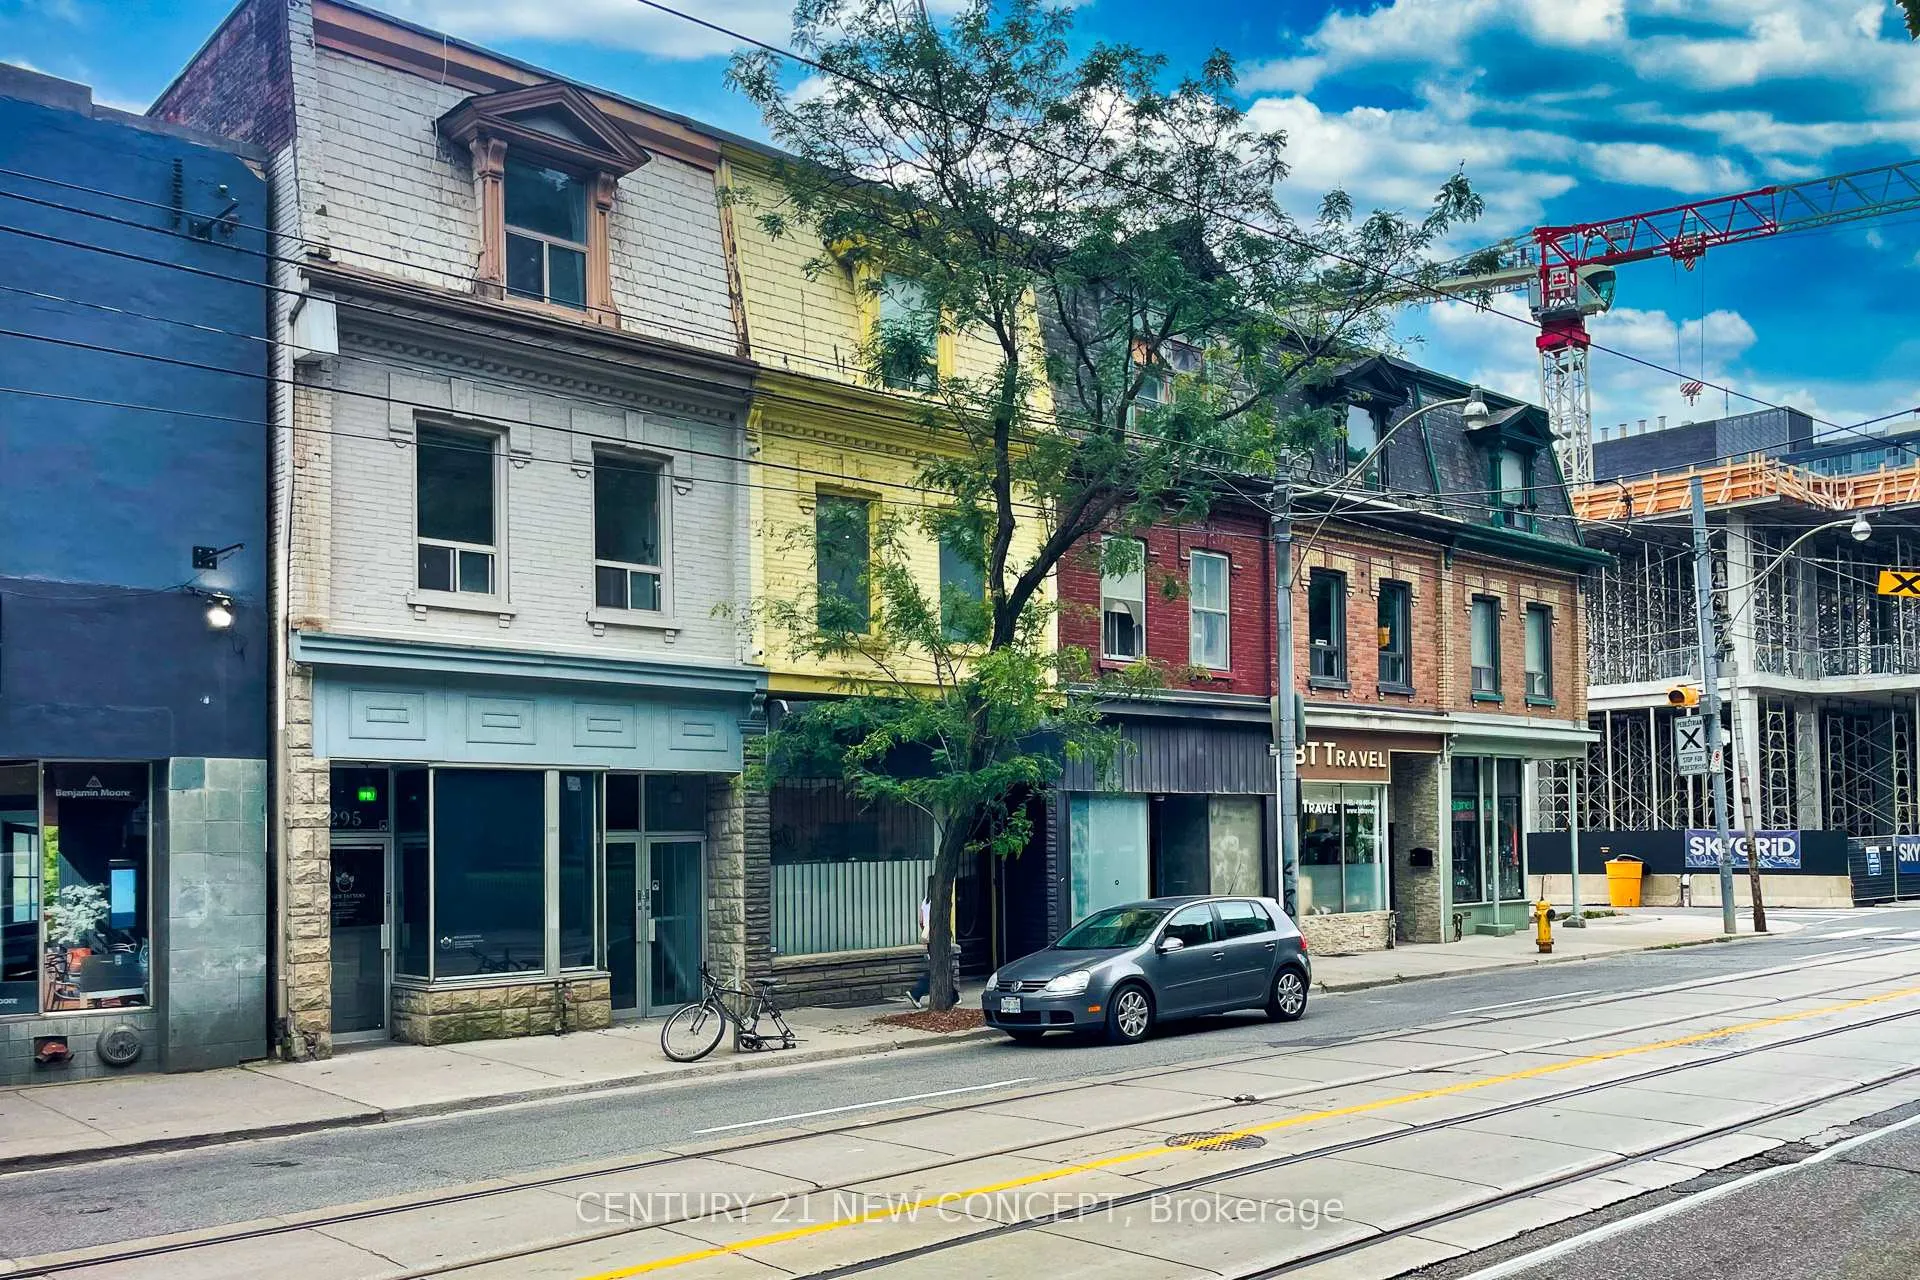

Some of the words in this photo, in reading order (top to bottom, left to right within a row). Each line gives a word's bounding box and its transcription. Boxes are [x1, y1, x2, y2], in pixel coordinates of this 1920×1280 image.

[1677, 719, 1702, 727] PEDESTRIAN
[1323, 742, 1387, 768] TRAVEL
[55, 789, 98, 799] Benjamin
[101, 789, 130, 797] Moore
[1302, 800, 1338, 814] TRAVEL
